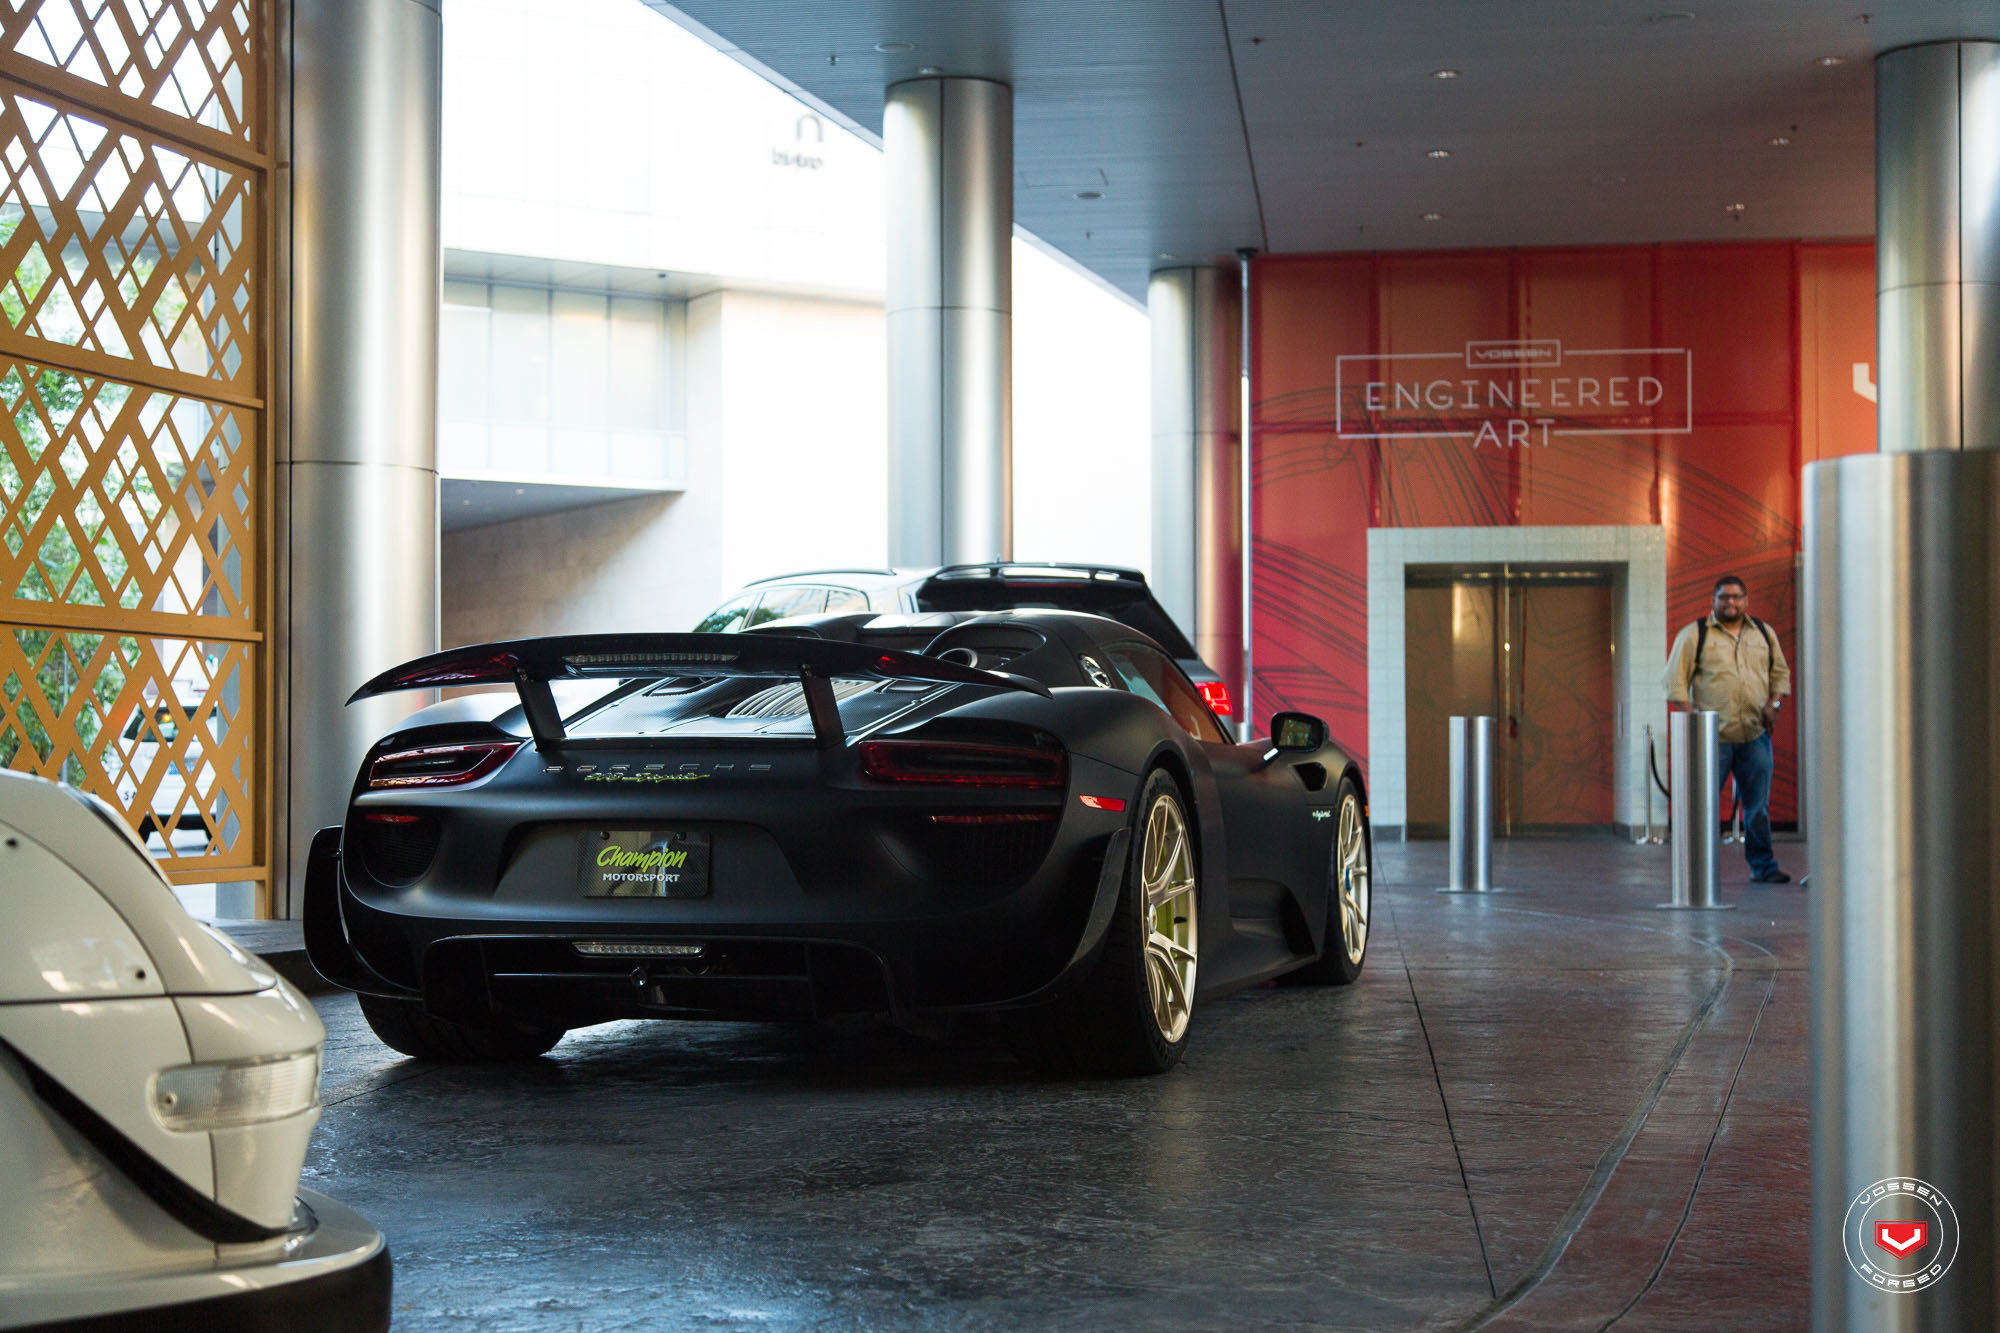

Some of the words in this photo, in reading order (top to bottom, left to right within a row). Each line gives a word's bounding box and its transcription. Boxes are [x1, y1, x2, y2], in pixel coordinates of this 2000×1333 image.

[1365, 376, 1663, 410] ENGINEERED
[1473, 418, 1555, 448] ART
[543, 763, 772, 773] PORSCHE
[596, 845, 688, 873] Champion
[602, 873, 680, 883] MOTORSPORT
